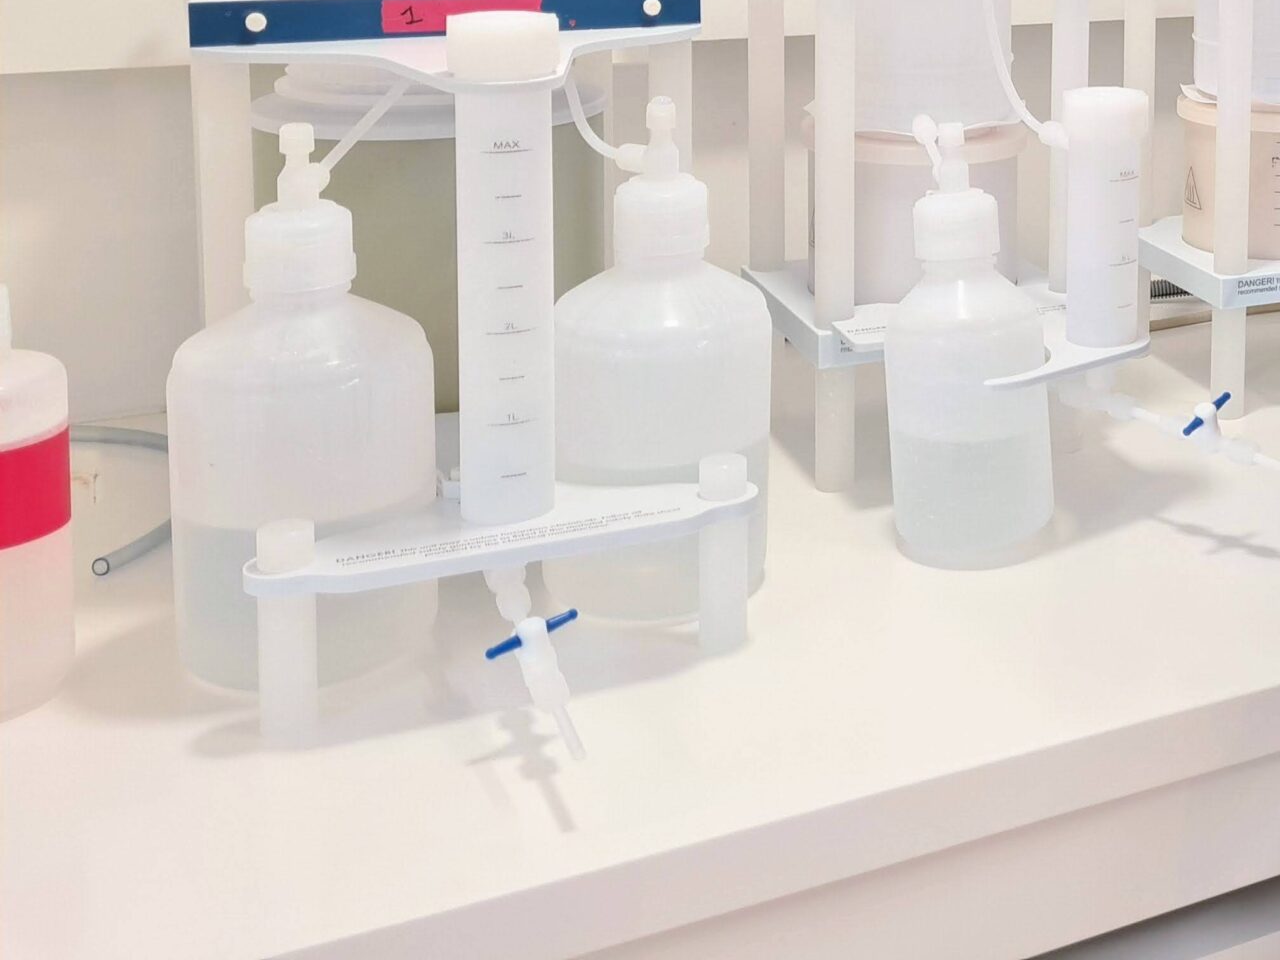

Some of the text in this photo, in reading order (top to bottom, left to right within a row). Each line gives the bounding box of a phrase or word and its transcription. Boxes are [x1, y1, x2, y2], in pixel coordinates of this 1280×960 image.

[400, 5, 424, 25] 1
[493, 140, 520, 150] MAX
[1237, 277, 1275, 289] DANGER!
[1237, 285, 1278, 296] recommended
